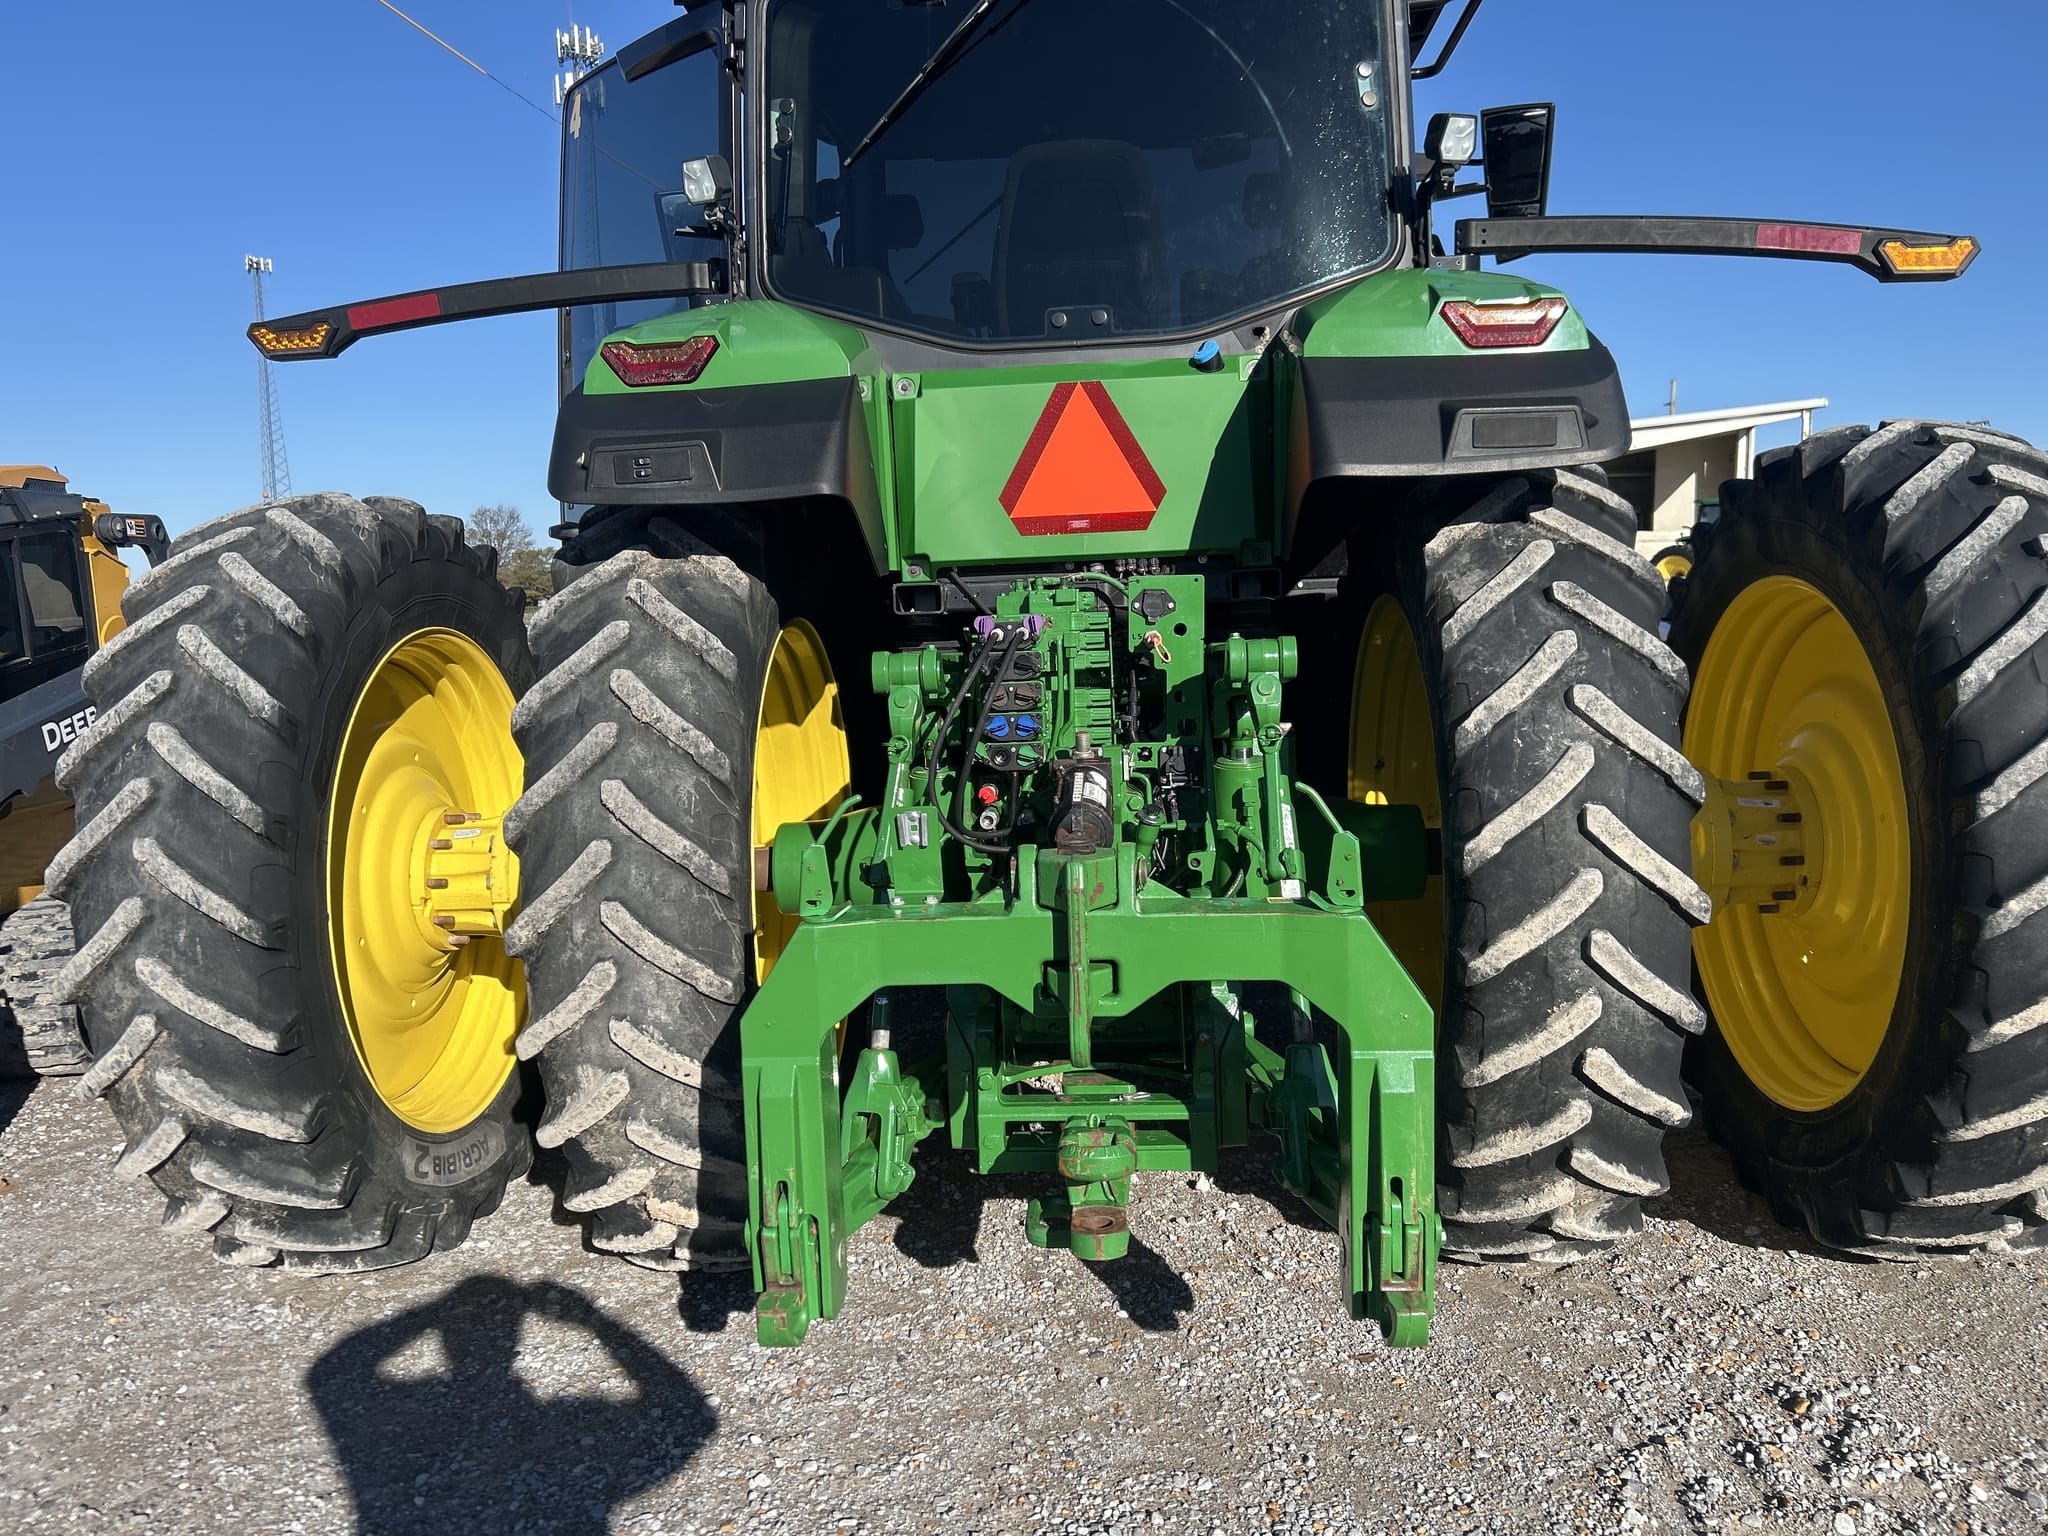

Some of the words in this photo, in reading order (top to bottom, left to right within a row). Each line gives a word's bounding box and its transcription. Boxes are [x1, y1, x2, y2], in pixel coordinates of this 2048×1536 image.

[41, 705, 97, 752] DEER
[414, 1142, 430, 1180] 2
[432, 1133, 490, 1176] AGRIBIB
